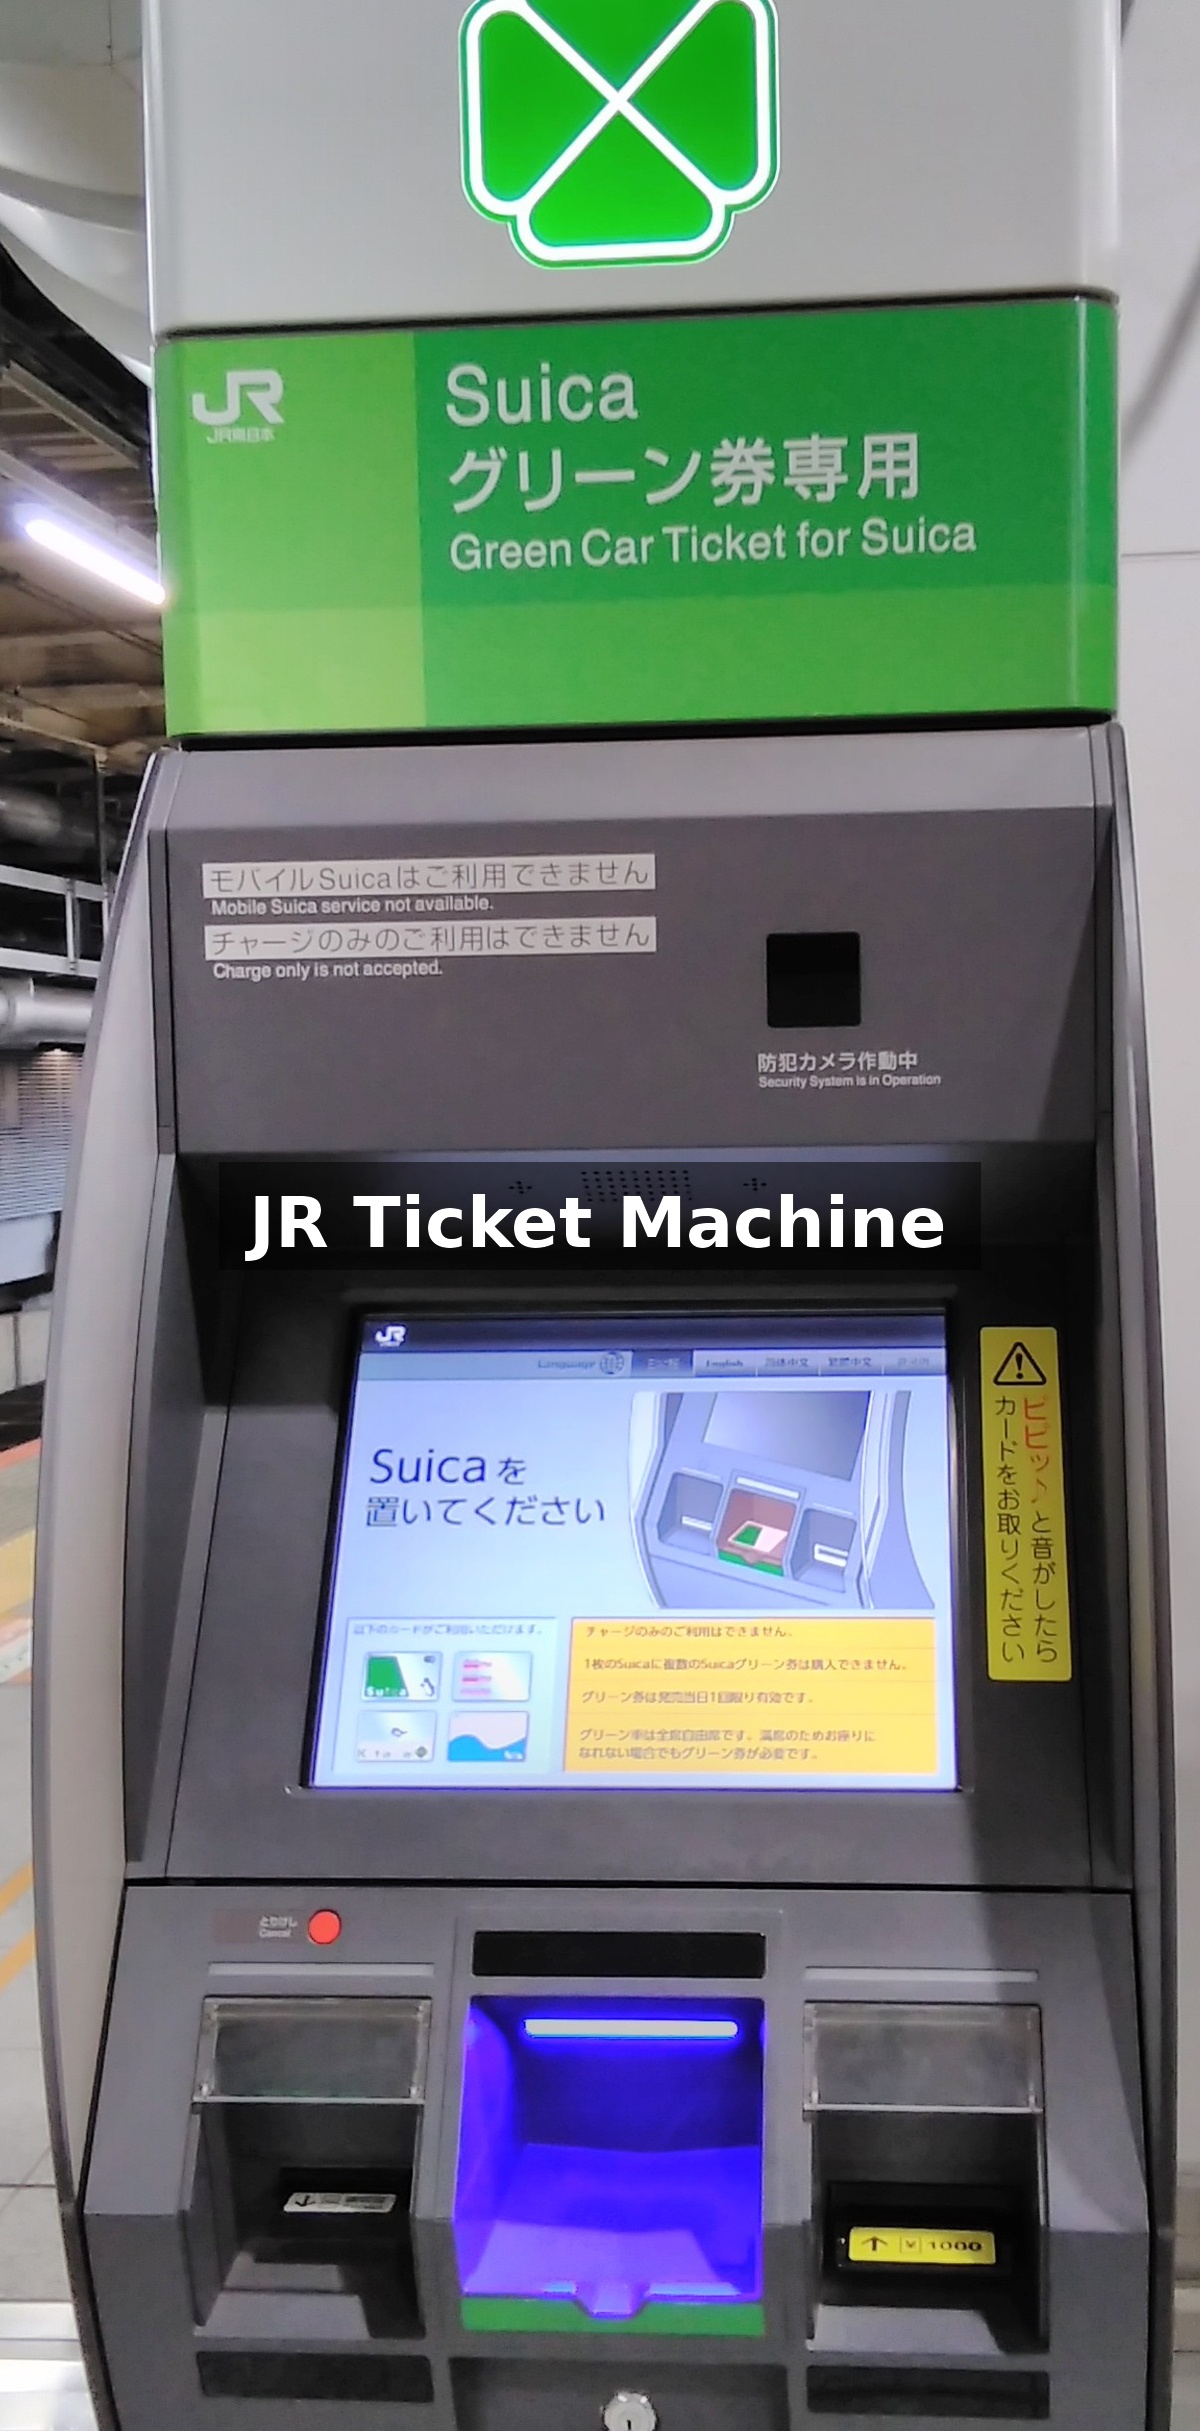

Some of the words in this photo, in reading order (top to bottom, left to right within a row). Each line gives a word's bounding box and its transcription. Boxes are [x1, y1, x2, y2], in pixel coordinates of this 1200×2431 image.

[192, 369, 284, 426] JR
[446, 362, 639, 427] Suica
[449, 432, 919, 514] グリーン券専用
[450, 532, 572, 571] Green
[582, 528, 655, 566] Car
[662, 523, 786, 563] Ticket
[796, 520, 852, 559] for
[861, 516, 977, 557] Suica
[210, 860, 649, 892] モバイルSuicaはご利用できません
[212, 899, 267, 916] Mobile
[271, 898, 318, 914] Suica
[322, 897, 380, 913] service
[385, 897, 411, 912] not
[414, 895, 494, 912] available.
[212, 923, 650, 956] チャージのみのご利用はできません
[213, 963, 271, 982] Charge
[275, 961, 310, 981] only
[314, 961, 329, 978] is
[333, 961, 359, 977] not
[363, 959, 443, 979] accepted.
[757, 1050, 918, 1073] 防犯カメラ作動中
[758, 1075, 806, 1090] Security
[809, 1074, 853, 1089] System
[856, 1075, 867, 1086] is
[869, 1074, 880, 1086] in
[882, 1073, 941, 1088] Operation
[369, 1449, 487, 1484] Suica
[366, 1495, 605, 1527] 置いてください
[994, 1395, 1025, 1664] カードをお取りください
[928, 2241, 983, 2252] 1000
